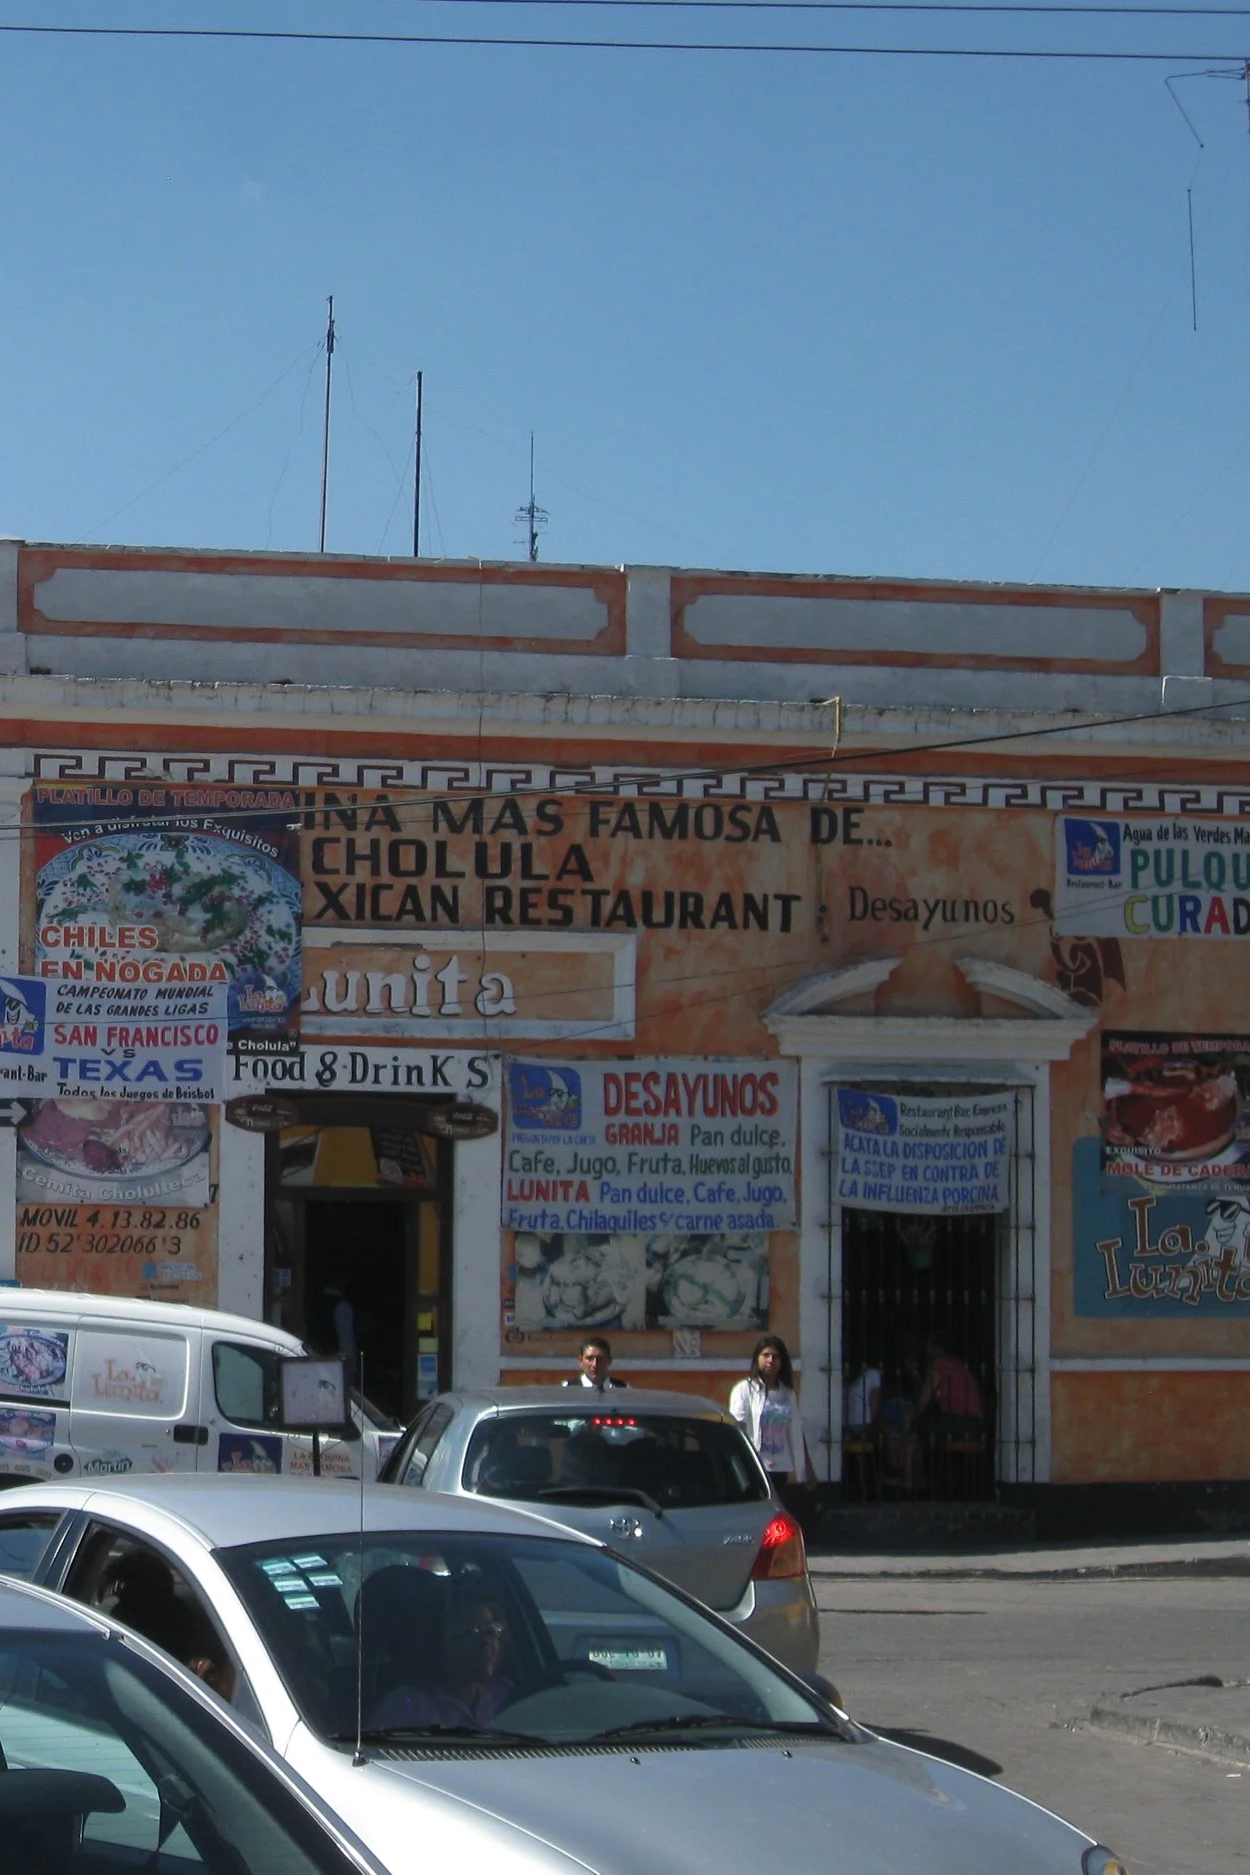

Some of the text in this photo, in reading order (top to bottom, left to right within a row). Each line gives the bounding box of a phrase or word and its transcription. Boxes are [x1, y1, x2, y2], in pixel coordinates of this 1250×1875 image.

[37, 787, 295, 809] PLATILLO DE TEMPORADA
[432, 798, 564, 837] MAS
[589, 801, 781, 843] FAMOSA
[1123, 823, 1153, 845] Agua
[1157, 824, 1170, 841] de
[1172, 822, 1189, 840] las
[1193, 826, 1231, 844] Verdes
[311, 837, 596, 882] CHOLULA
[301, 881, 802, 933] XICAN RESTAURANT
[849, 886, 1016, 931] Desayunos
[39, 924, 158, 949] CHILES
[41, 961, 229, 983] EN NOGADA
[56, 984, 214, 1000] CAMPEONATO MUNDIAL
[56, 1002, 209, 1017] DE LAS GRANDES LIGAS
[54, 1024, 98, 1047] SAN
[106, 1023, 219, 1048] FRANCISCO
[52, 1056, 204, 1082] TEXAS
[233, 1051, 307, 1083] Food
[119, 1085, 160, 1101] Juegos
[162, 1085, 175, 1099] de
[175, 1086, 215, 1100] Beisbol
[603, 1071, 780, 1118] DESAYUNOS
[605, 1122, 786, 1148] GRANJA Pan dulce,
[844, 1132, 1007, 1160] ACATA LA DISPOSICION DE
[508, 1150, 561, 1175] Cafe,
[566, 1152, 621, 1180] Jugo,
[689, 1154, 734, 1176] Huevos
[734, 1154, 750, 1176] al
[841, 1156, 1000, 1184] LA SSEP EN CONTRA DE
[1106, 1162, 1154, 1177] MOLE
[1160, 1163, 1182, 1177] DE
[24, 1167, 207, 1200] Cemita Cholulteca
[506, 1178, 590, 1203] LUNITA
[600, 1182, 632, 1204] Pan
[838, 1179, 999, 1206] LA INFLUENZA PORCINA
[19, 1207, 78, 1228] MOVIL
[567, 1208, 656, 1234] Chilaquiles
[676, 1212, 723, 1232] carne
